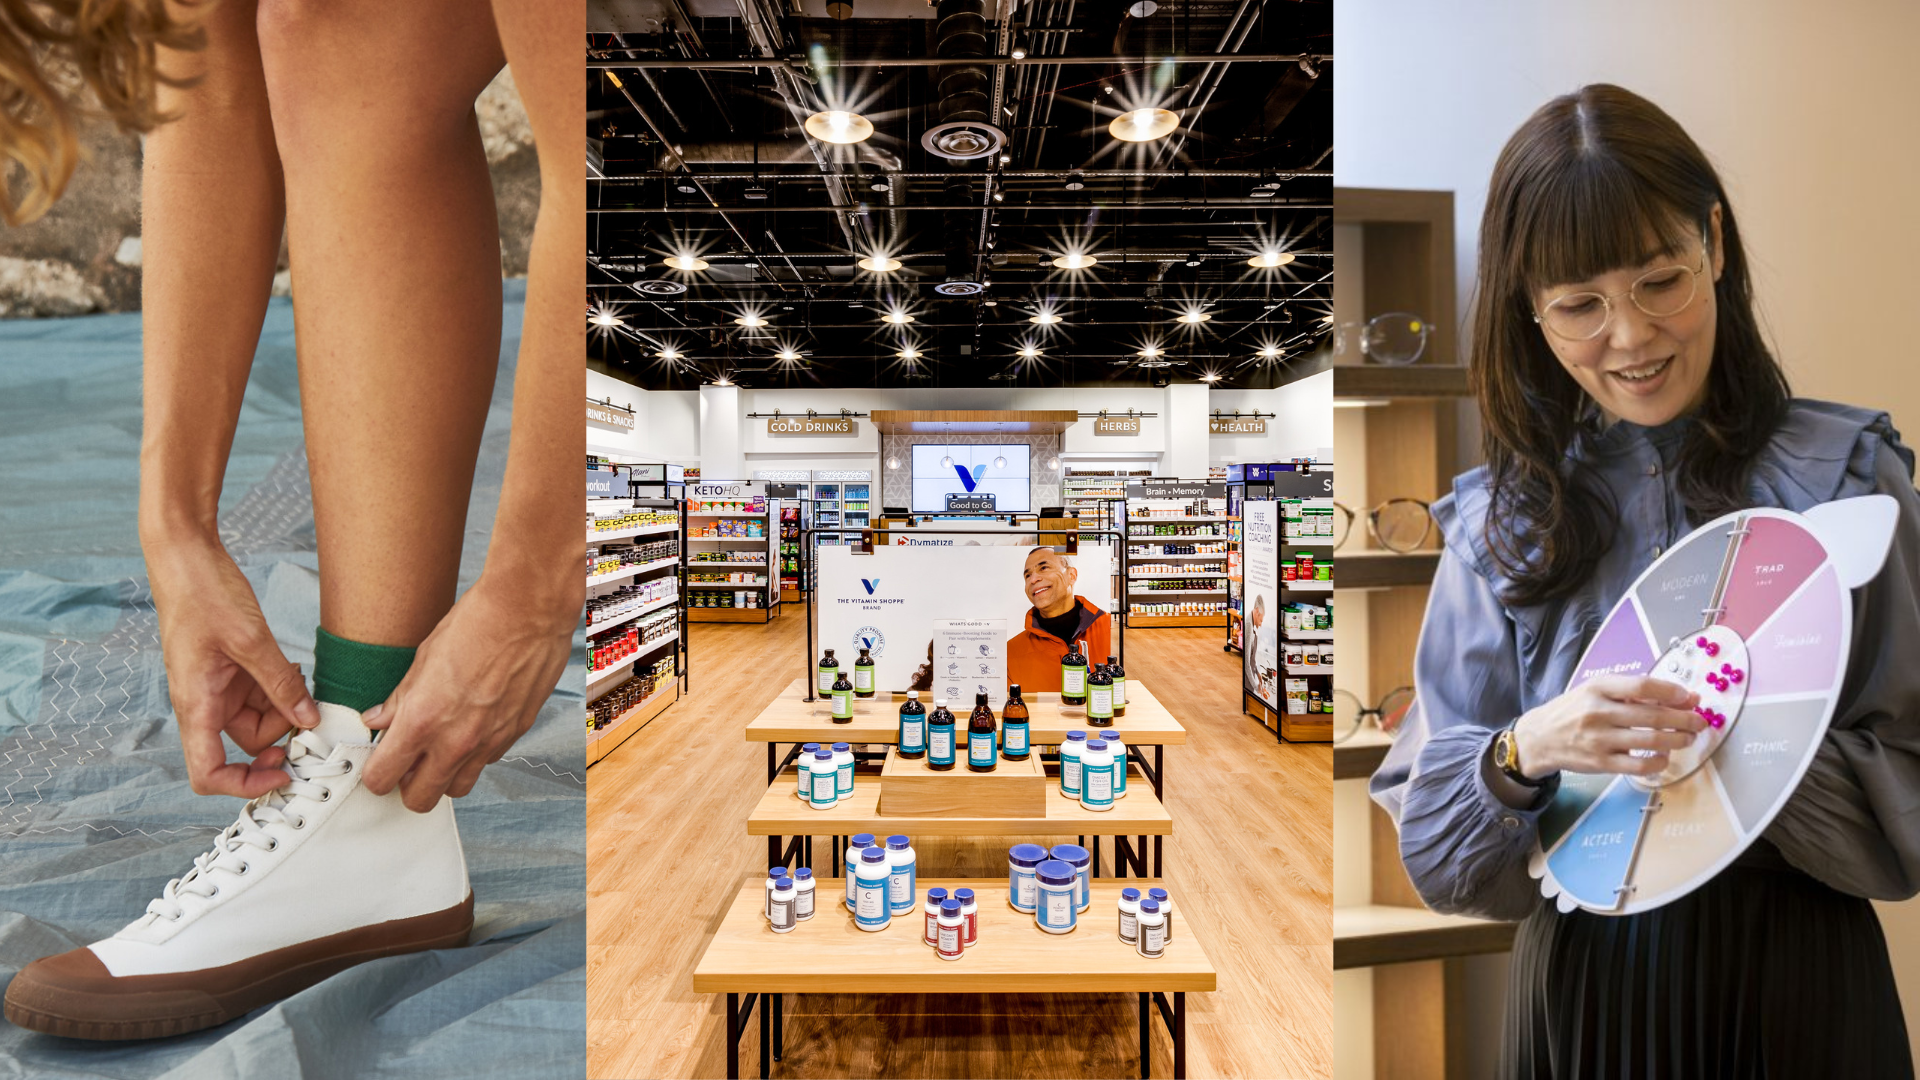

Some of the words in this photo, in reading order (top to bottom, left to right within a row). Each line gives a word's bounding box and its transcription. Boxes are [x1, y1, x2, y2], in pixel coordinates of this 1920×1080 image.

[586, 408, 606, 422] RINKS
[612, 414, 634, 428] SNACKS
[771, 422, 802, 432] COLD
[806, 422, 849, 432] DRINKS
[1100, 422, 1137, 431] HERBS
[1220, 423, 1263, 432] HEALTH
[1172, 488, 1205, 496] Memory
[949, 501, 970, 509] Good
[981, 501, 992, 509] Go
[1254, 512, 1265, 522] FREE
[1247, 522, 1272, 533] NUTRITION
[1248, 532, 1272, 544] COACHING
[1755, 564, 1784, 574] TRAD
[1660, 573, 1709, 591] MODERN
[853, 627, 868, 645] QUALITY
[1743, 740, 1789, 754] ETHNIC
[1582, 831, 1624, 847] ACTIVE
